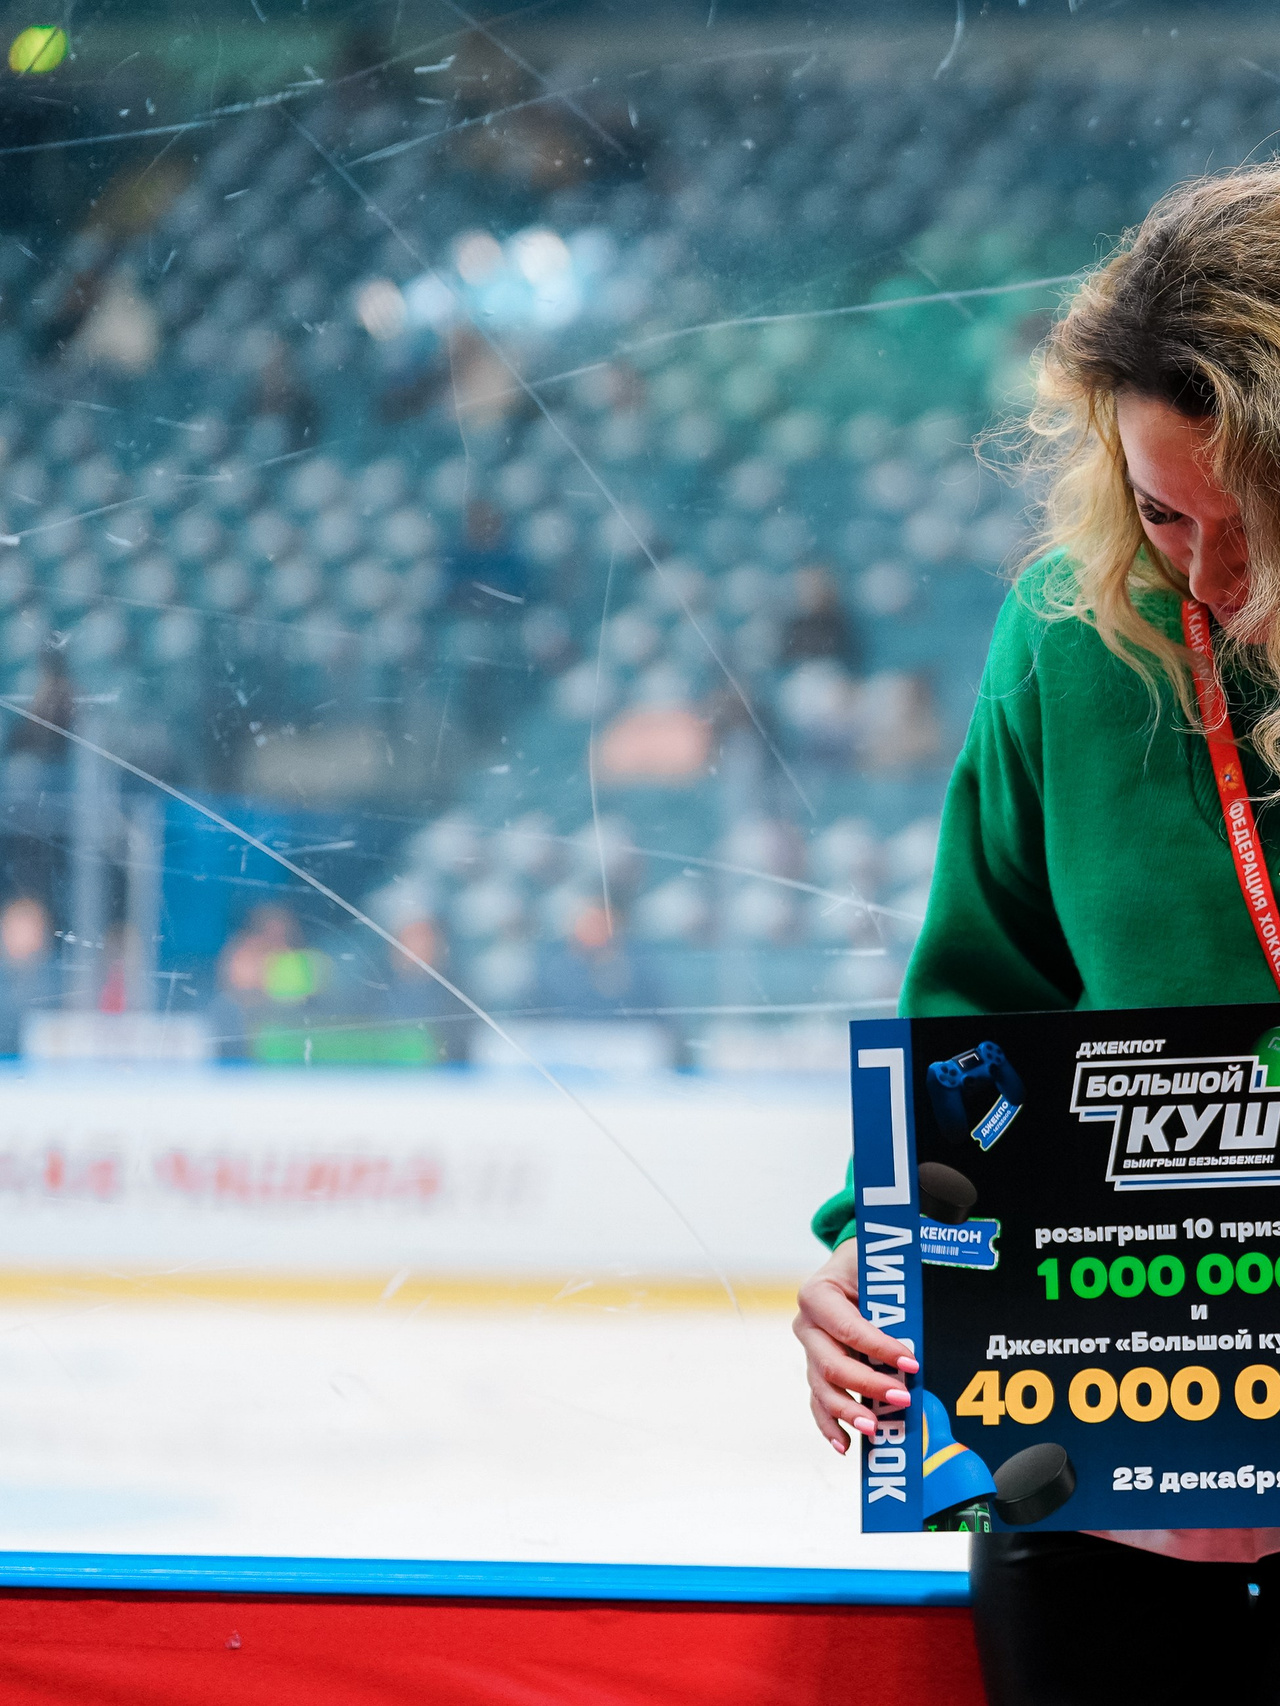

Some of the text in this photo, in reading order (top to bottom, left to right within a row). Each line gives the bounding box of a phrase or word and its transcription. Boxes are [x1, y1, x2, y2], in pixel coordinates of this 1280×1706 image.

[1229, 802, 1268, 911] ФЕДЕРАЦИЯ
[1075, 1039, 1166, 1058] ДЖЕКПОТ
[1085, 1064, 1244, 1098] БОЛЬШОЙ
[1123, 1154, 1275, 1169] ВЫИГРЫШ БЕЗЫЗБЕЖЕН!
[1035, 1223, 1177, 1249] розыгрыш
[1183, 1218, 1214, 1239] 10
[1190, 1304, 1208, 1321] и
[986, 1334, 1111, 1360] Джекпот
[1114, 1328, 1253, 1353] «Большой
[956, 1369, 1055, 1426] 40
[1068, 1365, 1221, 1424] 000
[1112, 1466, 1154, 1492] 23
